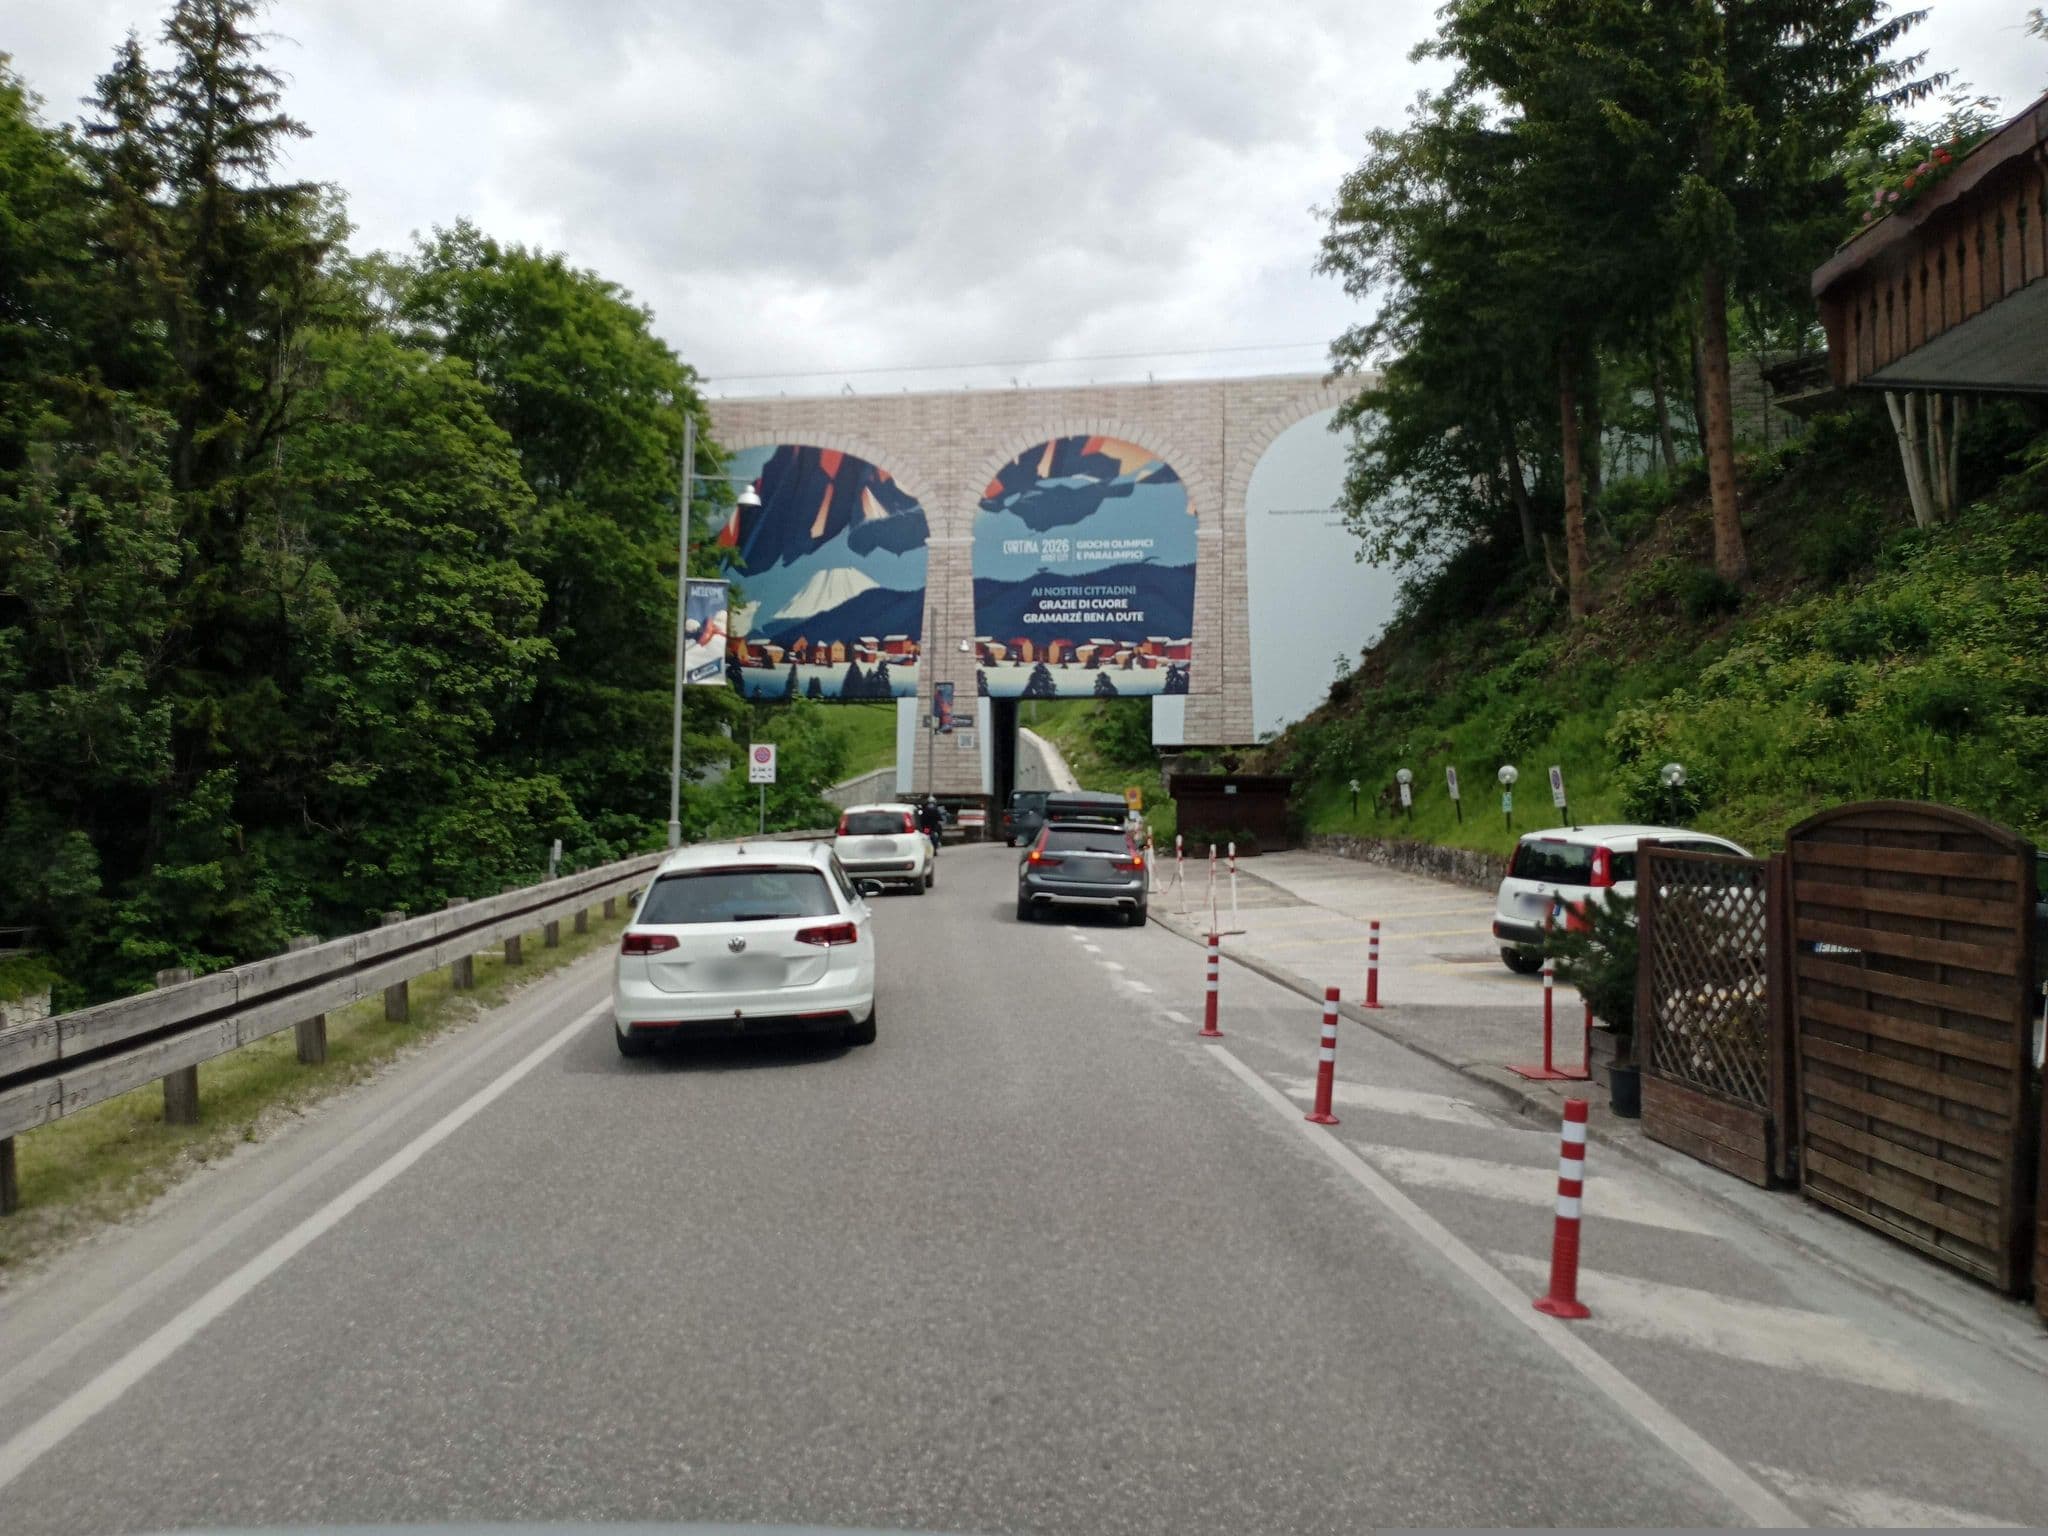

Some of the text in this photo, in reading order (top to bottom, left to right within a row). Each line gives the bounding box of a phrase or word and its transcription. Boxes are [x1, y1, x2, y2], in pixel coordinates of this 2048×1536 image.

[1042, 538, 1070, 553] 2026
[1076, 538, 1154, 549] GIOCHI OLIMPICI
[1076, 551, 1083, 560] E
[1084, 550, 1144, 560] PARALIMPICI
[1031, 585, 1136, 596] AI NOSTRI CITTADINI
[1039, 598, 1128, 610] GRAZIE DI CUORE
[1084, 612, 1104, 622] BEN
[1106, 612, 1115, 622] A
[1116, 611, 1144, 622] DUTE
